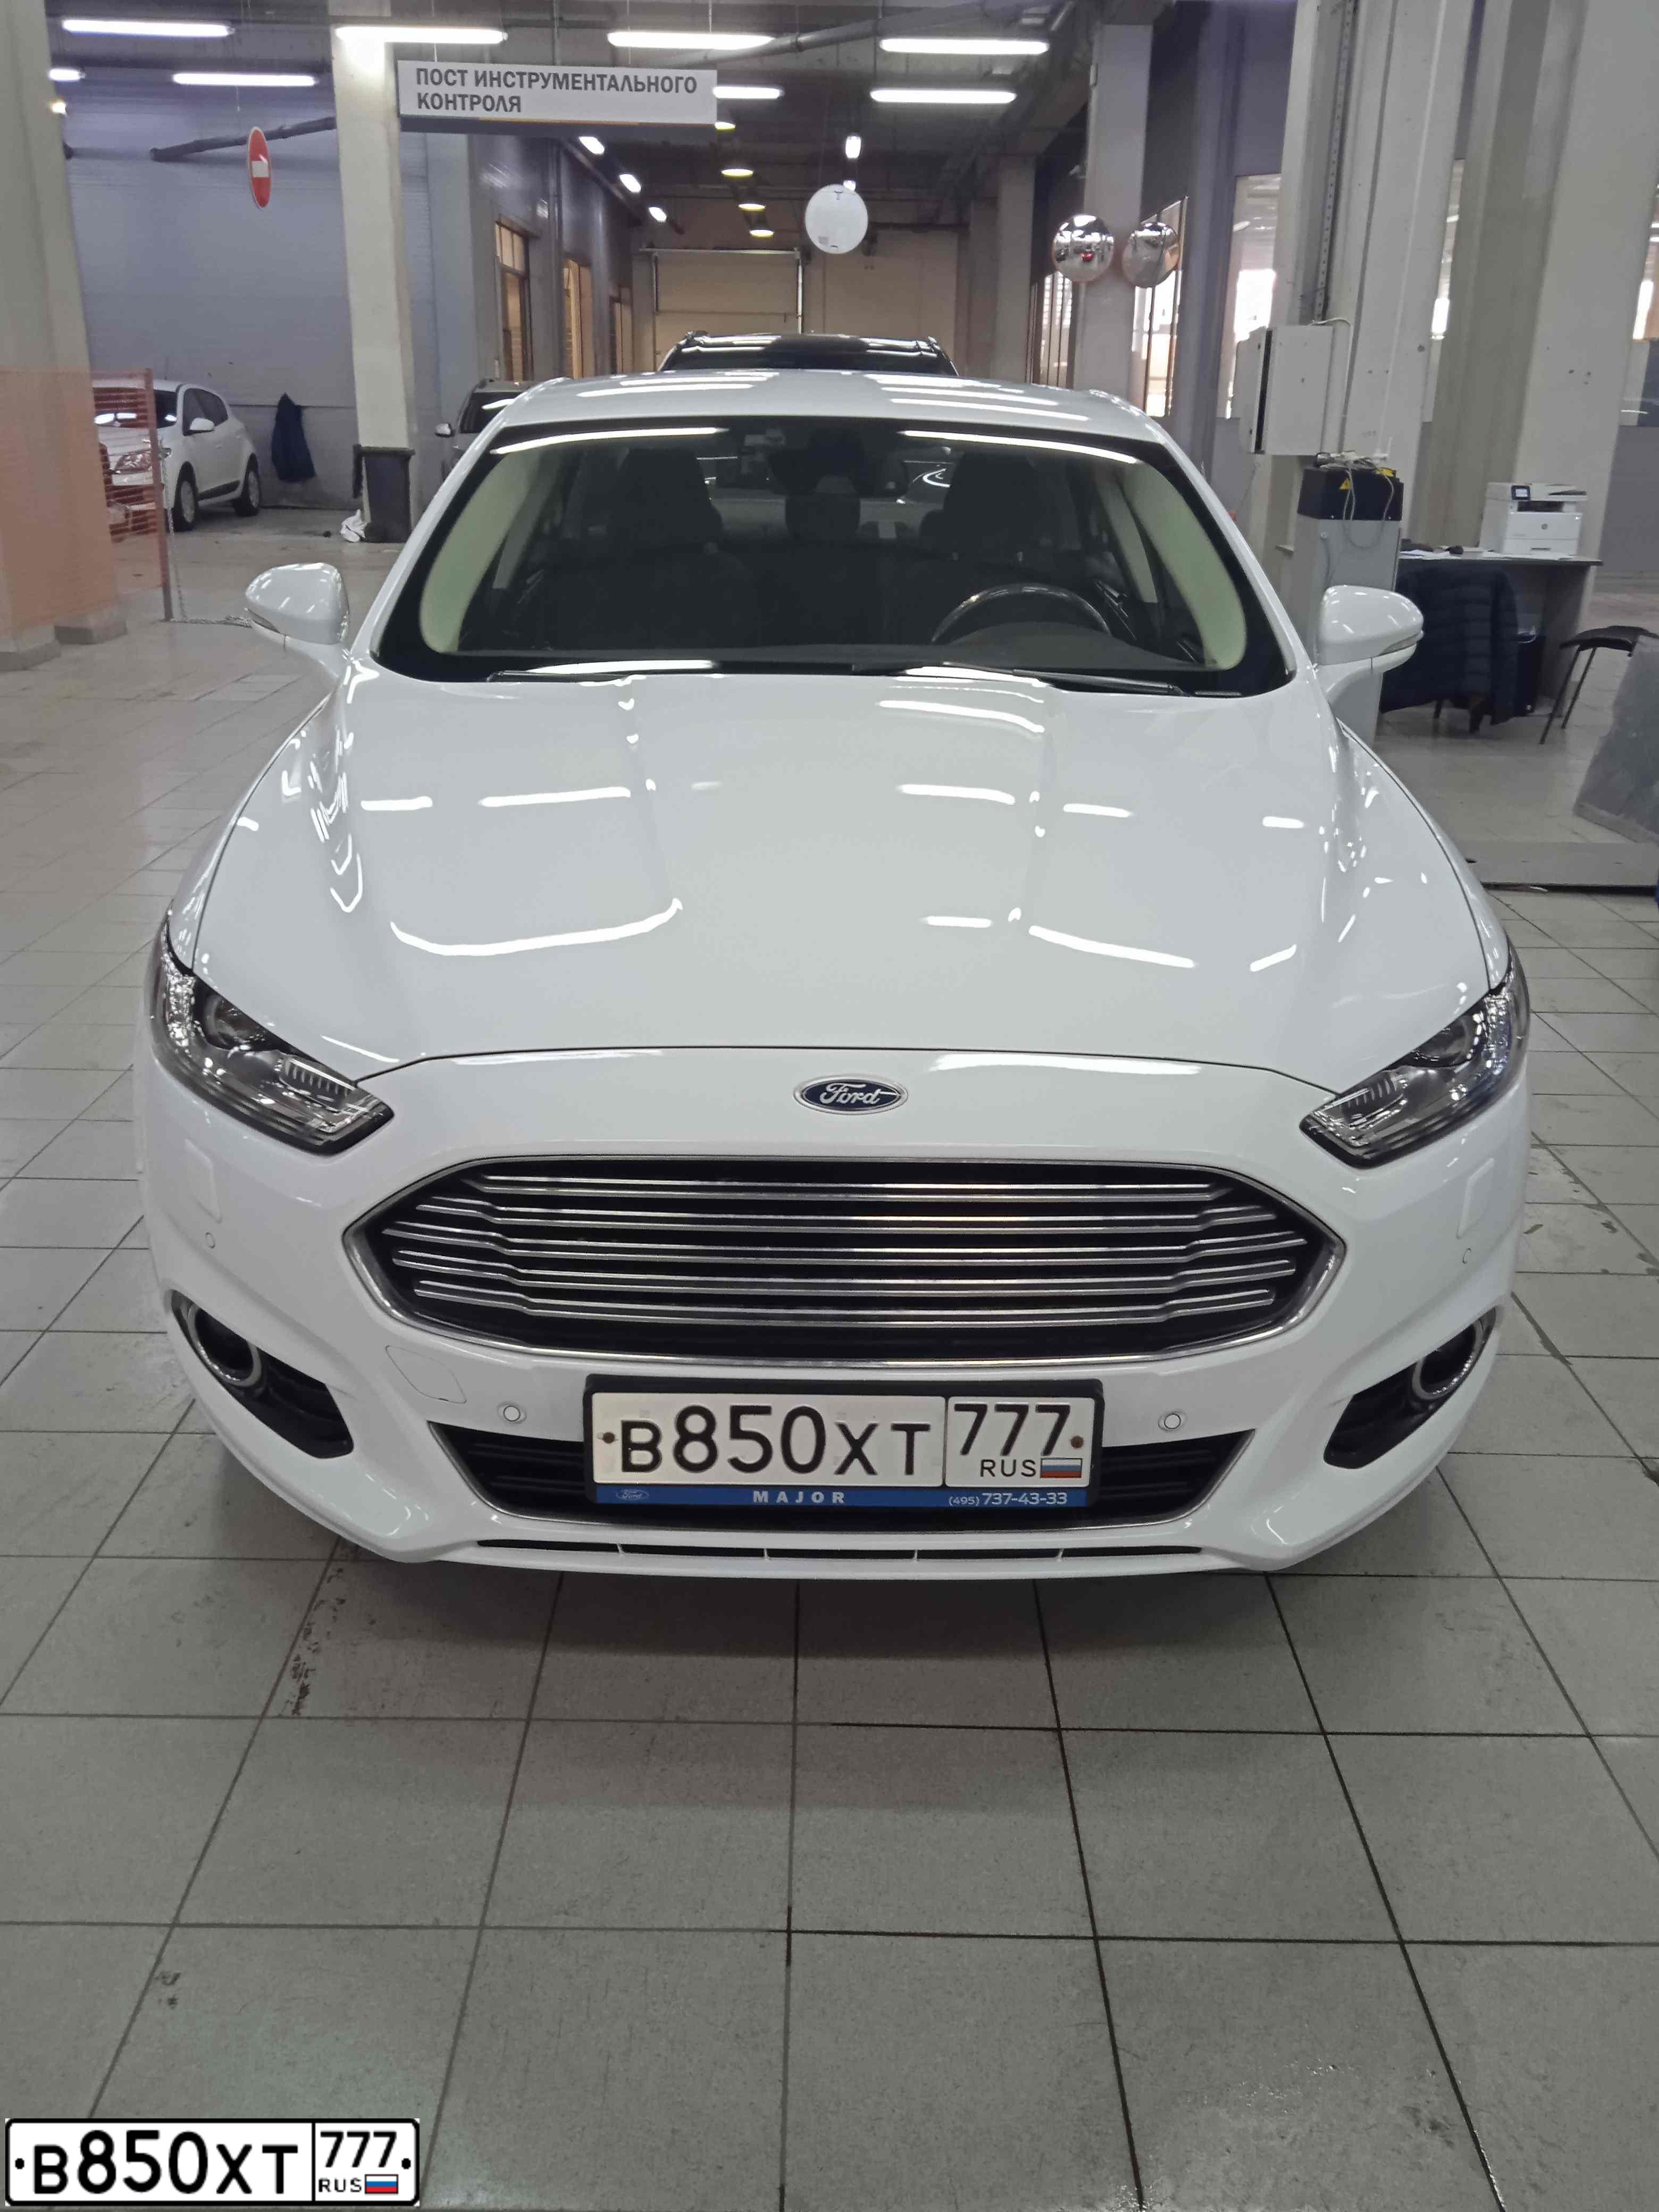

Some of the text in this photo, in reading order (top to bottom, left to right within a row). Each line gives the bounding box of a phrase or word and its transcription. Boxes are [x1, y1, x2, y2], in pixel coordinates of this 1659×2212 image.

[416, 68, 697, 94] ПОСТ ИНСТРУМЕНТАЛЬНОГО
[418, 93, 521, 113] КОНТРОЛЯ
[819, 1082, 884, 1104] Ford
[621, 1403, 1071, 1476] В850ХТ 777
[979, 1459, 1036, 1478] RUS
[753, 1490, 844, 1504] MAJOR
[949, 1492, 1068, 1506] (495) 737-43-33
